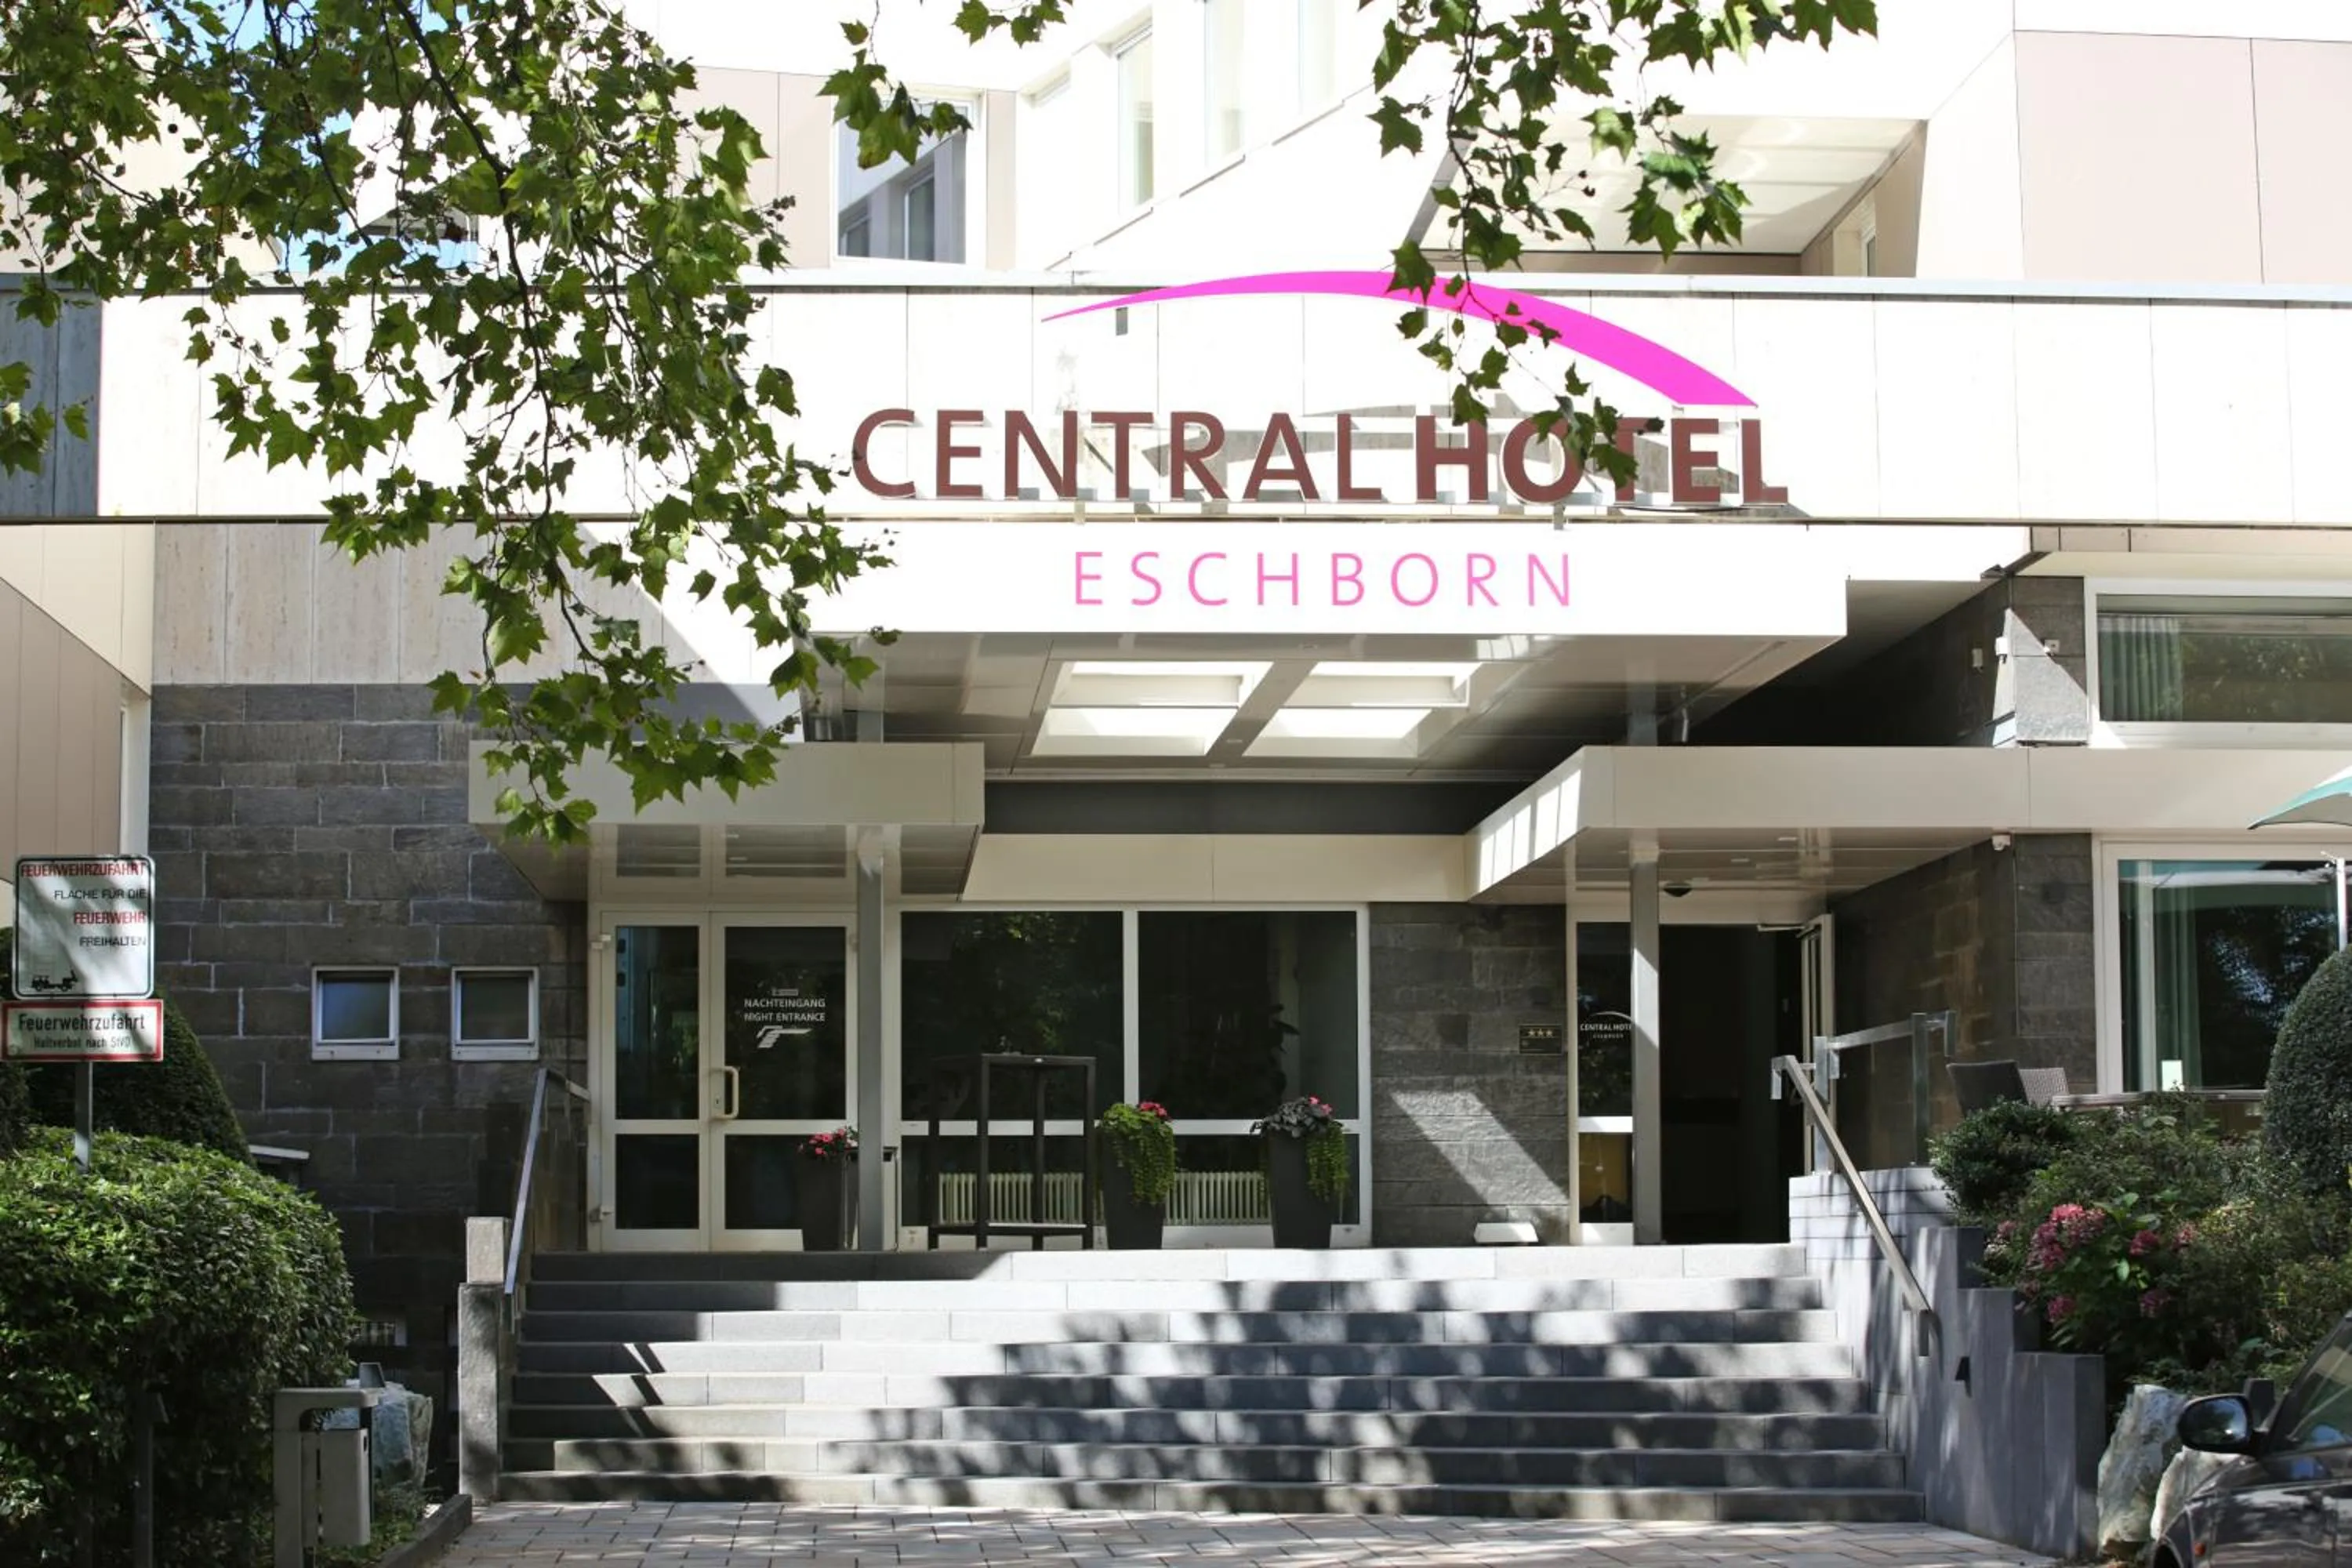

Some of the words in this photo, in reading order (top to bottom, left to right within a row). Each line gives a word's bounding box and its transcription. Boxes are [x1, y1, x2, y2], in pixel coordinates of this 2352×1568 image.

[1075, 551, 1570, 607] ESCHBORN
[21, 862, 146, 878] FEUERWEHRZUFAHRT
[128, 888, 147, 899] DIE
[74, 912, 146, 924] FEUERWEHR
[79, 936, 147, 947] FREIHALTEN
[744, 998, 826, 1008] NACHTEINGANG
[19, 1012, 146, 1031] Feuerwehrzufahrt
[744, 1012, 774, 1022] NIGHT
[776, 1012, 826, 1022] ENTRANCE
[85, 1036, 107, 1048] nach
